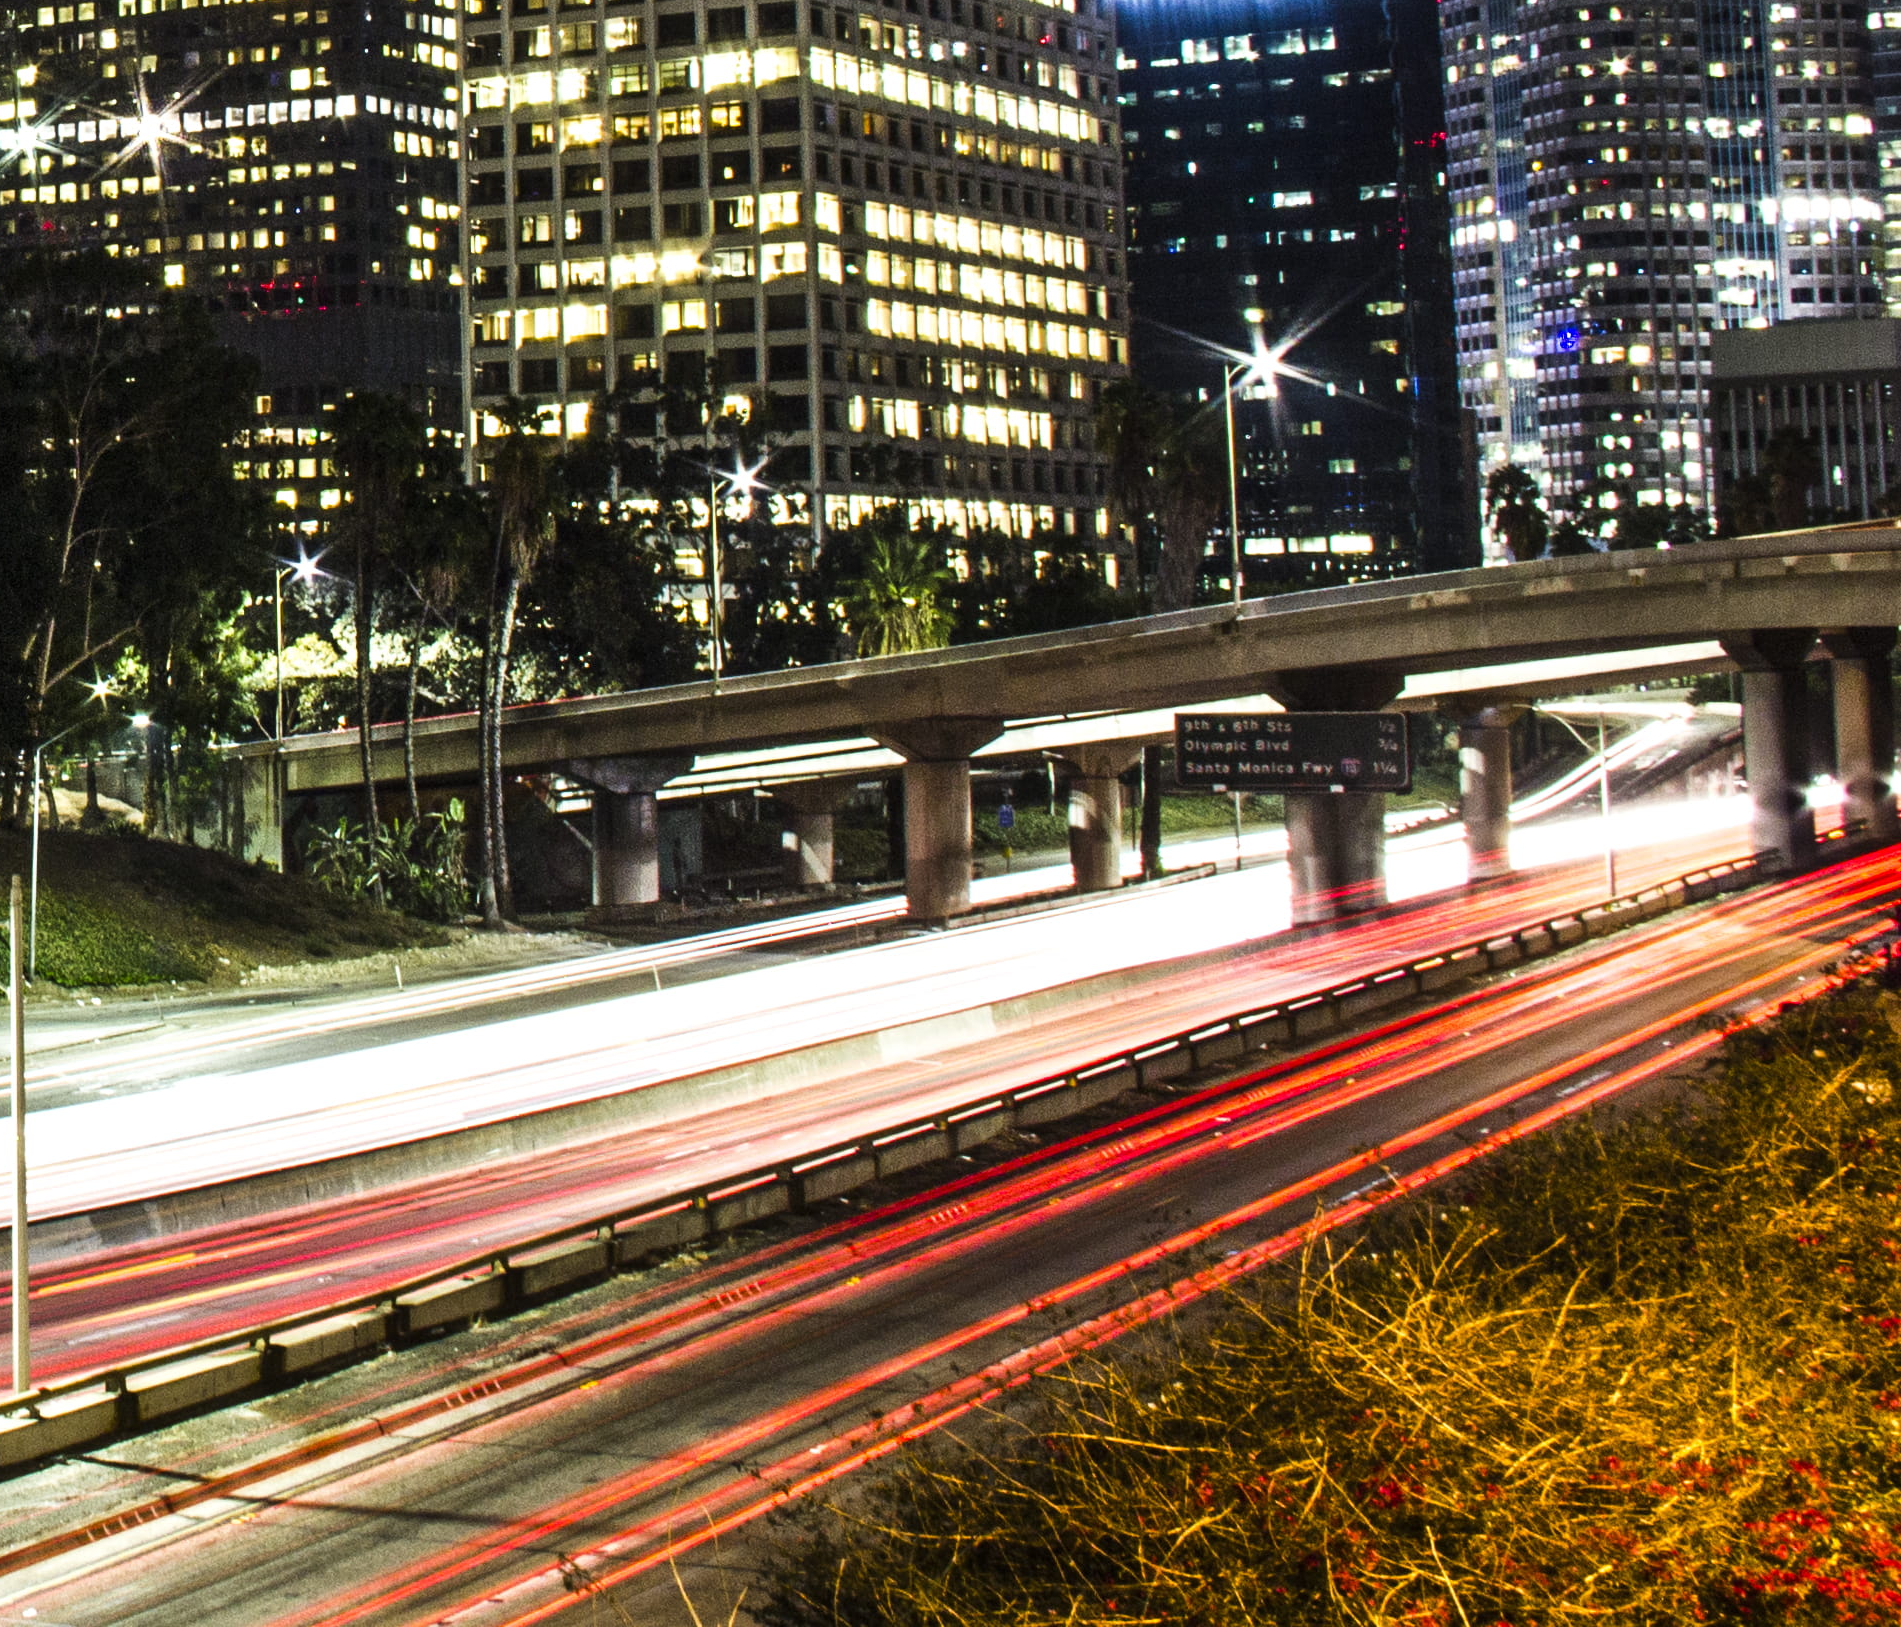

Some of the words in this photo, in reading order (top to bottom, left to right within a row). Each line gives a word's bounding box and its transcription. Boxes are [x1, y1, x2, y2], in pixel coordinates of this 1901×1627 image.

[1184, 719, 1210, 732] 9th
[1267, 720, 1292, 733] Sts
[1184, 739, 1247, 754] Olympic
[1255, 739, 1291, 752] Blvd
[1186, 761, 1230, 774] Santa
[1238, 761, 1294, 774] Monica
[1302, 761, 1333, 777] Fwy
